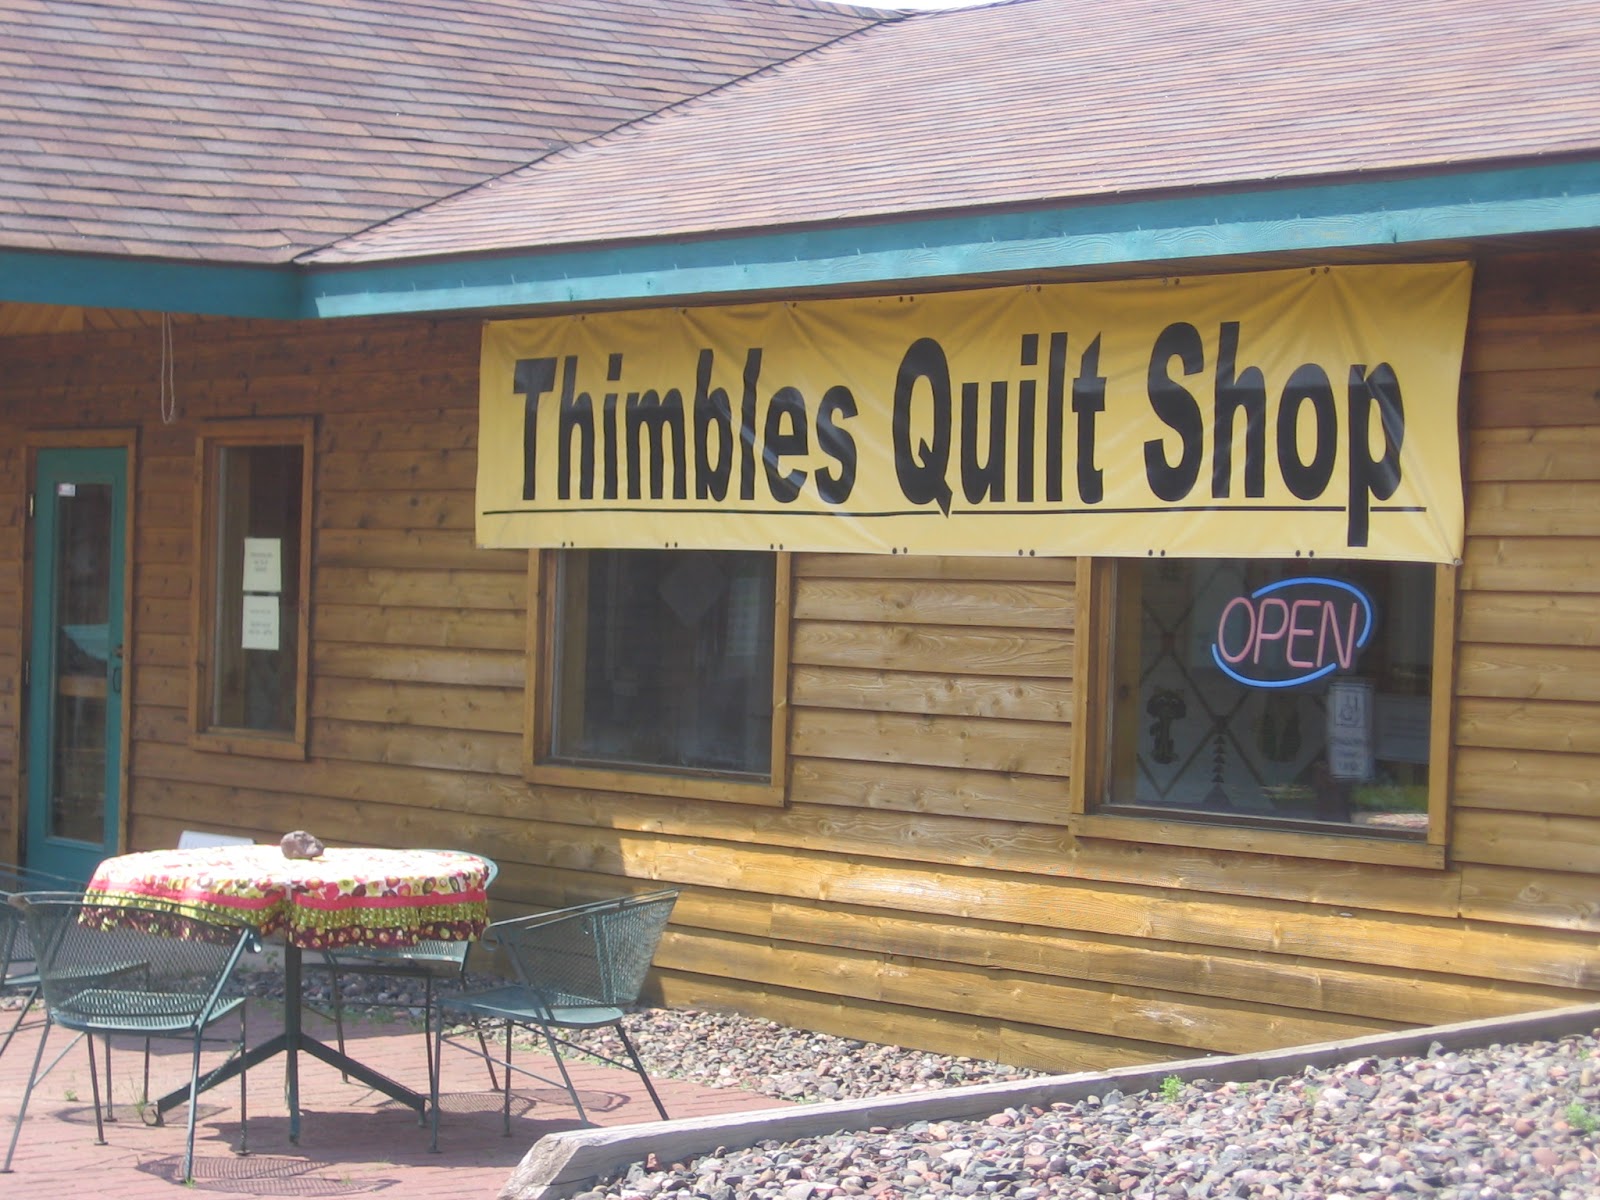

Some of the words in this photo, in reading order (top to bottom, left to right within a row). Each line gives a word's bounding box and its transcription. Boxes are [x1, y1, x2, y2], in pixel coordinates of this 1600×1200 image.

[513, 348, 858, 504] Thimbles
[892, 331, 1107, 518] Quilt
[1144, 321, 1405, 547] Shop
[1218, 597, 1358, 669] OPEN
